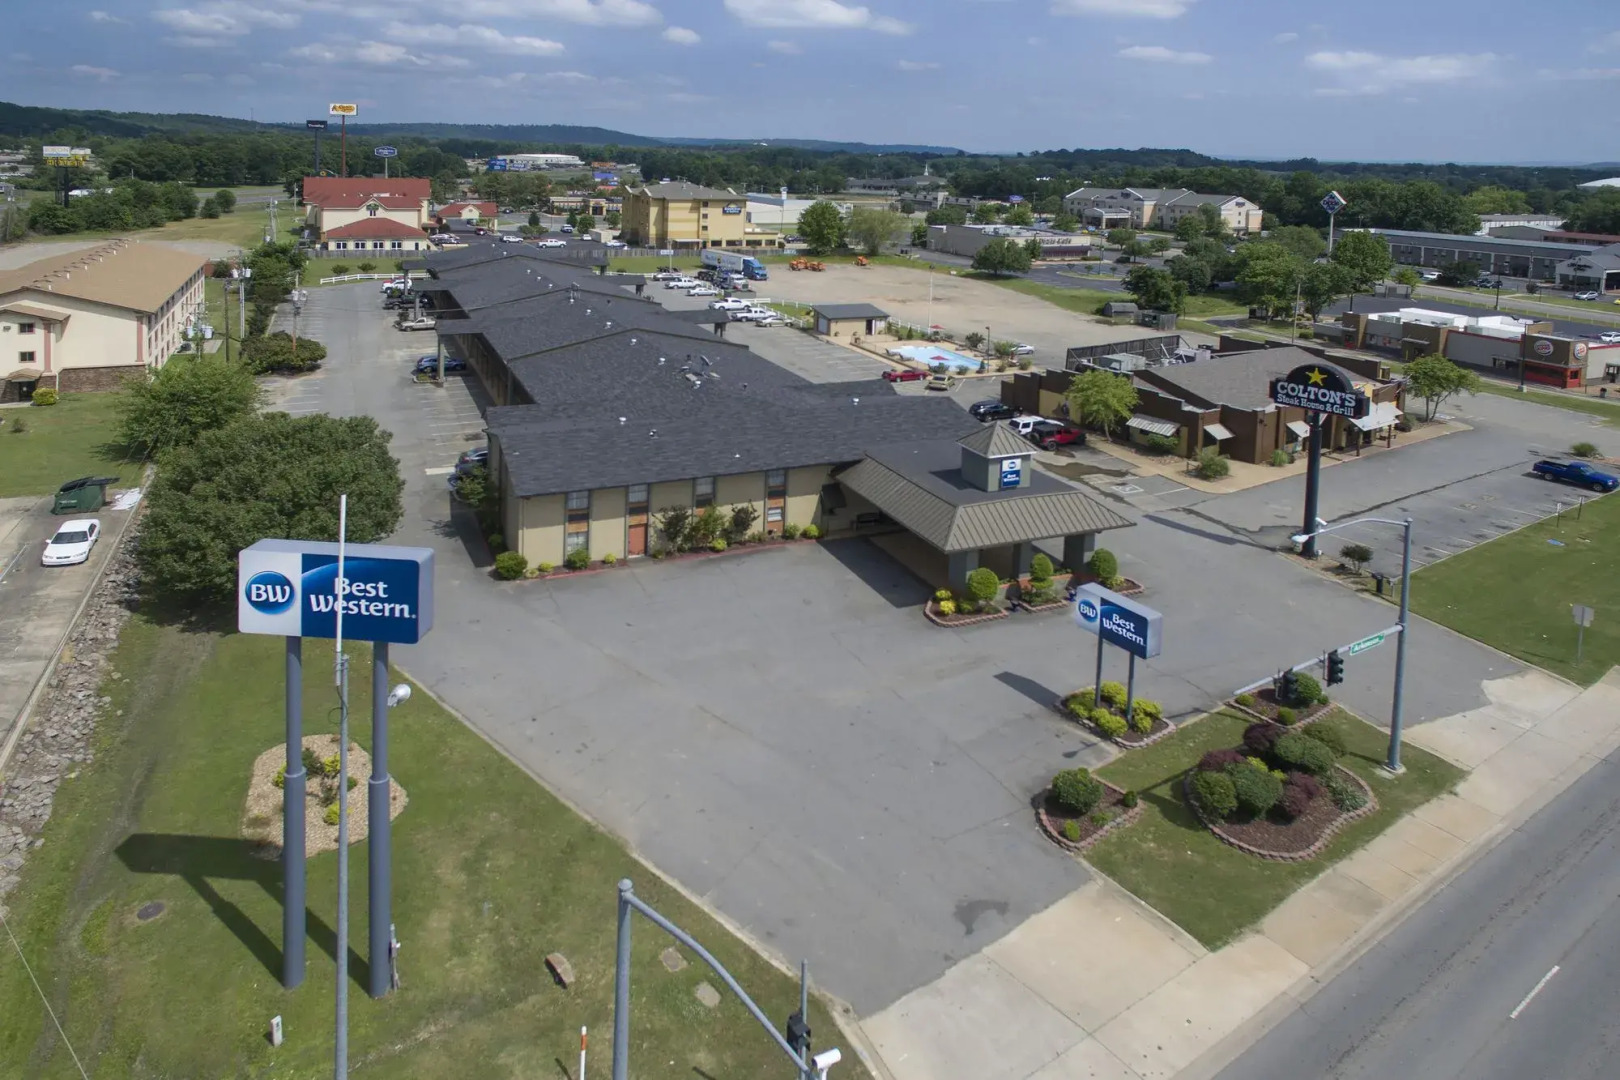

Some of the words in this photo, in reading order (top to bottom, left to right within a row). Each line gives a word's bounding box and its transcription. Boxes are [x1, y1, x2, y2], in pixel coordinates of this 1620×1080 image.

[1277, 381, 1357, 407] COLTON'S
[1277, 393, 1300, 406] Steak
[1301, 397, 1325, 411] House
[1325, 404, 1333, 413] &
[1333, 403, 1355, 417] Grill
[250, 583, 291, 604] BW
[334, 577, 389, 599] Best
[1080, 603, 1096, 618] BW
[1112, 613, 1136, 632] Best
